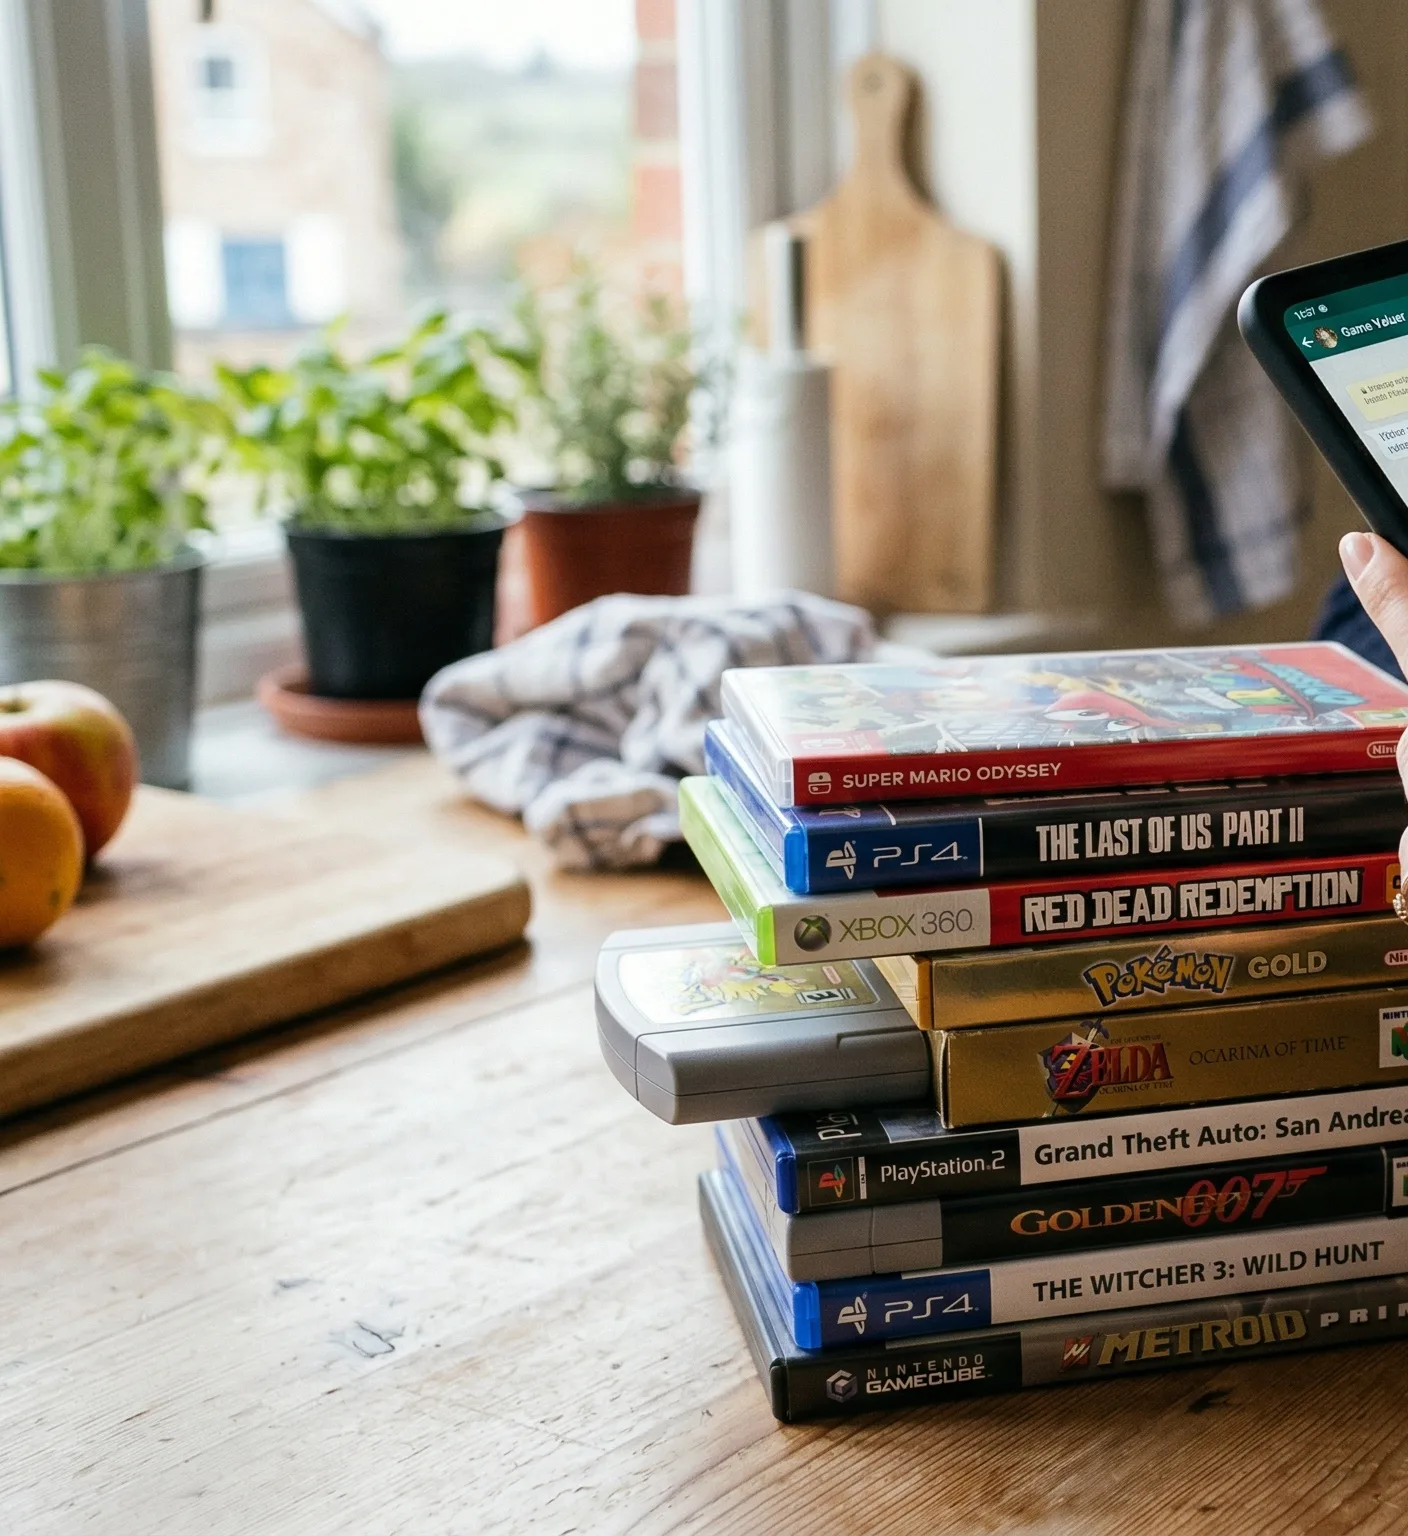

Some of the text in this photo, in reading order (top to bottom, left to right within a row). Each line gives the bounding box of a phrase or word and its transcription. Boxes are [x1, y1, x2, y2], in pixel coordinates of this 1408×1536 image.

[1340, 322, 1373, 337] Game
[842, 762, 1062, 789] SUPER MARIO ODYSSEY
[1036, 807, 1304, 862] THE LAST OF US PART II
[872, 841, 963, 868] PS4
[1024, 870, 1359, 933] RED DEAD REDEMPTION
[838, 908, 974, 943] XBOX 360
[1248, 950, 1327, 979] GOLD
[1188, 1036, 1348, 1066] OCARINA OF TIME
[1051, 1042, 1174, 1100] ZELDA
[1034, 1134, 1113, 1166] Grand
[1121, 1128, 1190, 1156] Theft
[1197, 1123, 1266, 1148] Auto:
[1275, 1116, 1321, 1139] San
[881, 1154, 986, 1186] PlayStation
[1183, 1171, 1288, 1228] 007
[1033, 1240, 1385, 1302] THE WITCHER 3: WILD HUNT
[884, 1292, 974, 1323] PS4
[1097, 1309, 1307, 1366] METROID
[866, 1366, 986, 1394] GAMECUBE
[867, 1354, 984, 1380] NINTENDO
